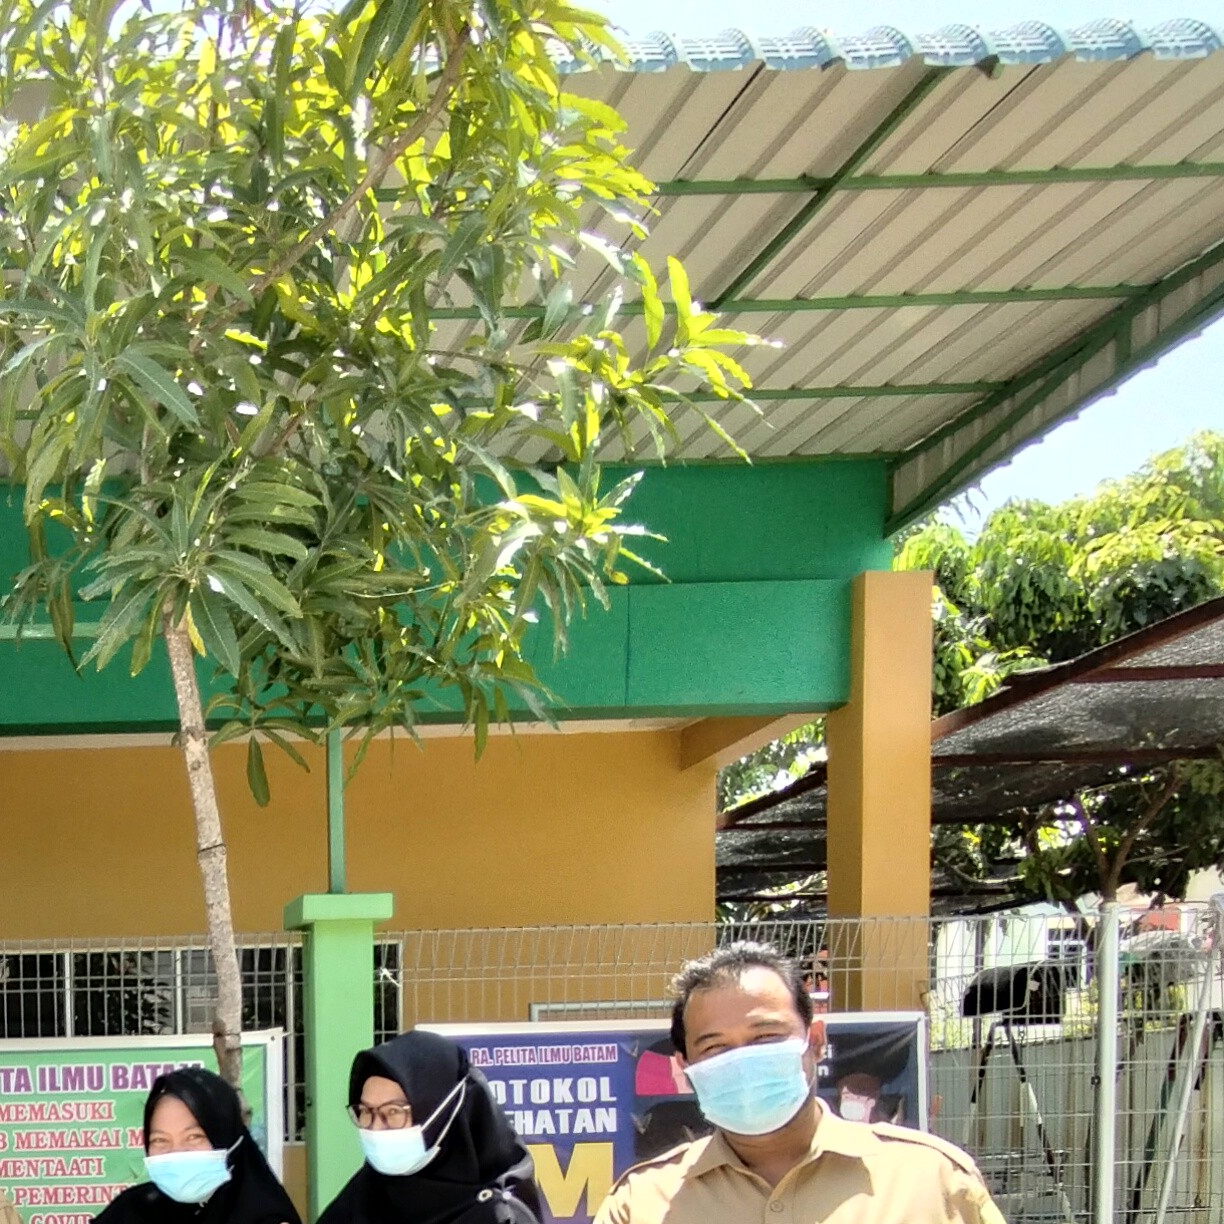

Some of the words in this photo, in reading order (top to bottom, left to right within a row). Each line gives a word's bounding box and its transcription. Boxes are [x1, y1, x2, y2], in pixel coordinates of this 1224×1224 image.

[472, 1049, 493, 1066] RA.
[495, 1047, 537, 1065] PELITA
[538, 1046, 571, 1063] ILMU
[573, 1044, 617, 1062] BATAM
[38, 1065, 104, 1092] ILMU
[112, 1062, 202, 1090] BAT
[487, 1077, 617, 1104] OTOKOL
[15, 1129, 121, 1149] MEMAKAI
